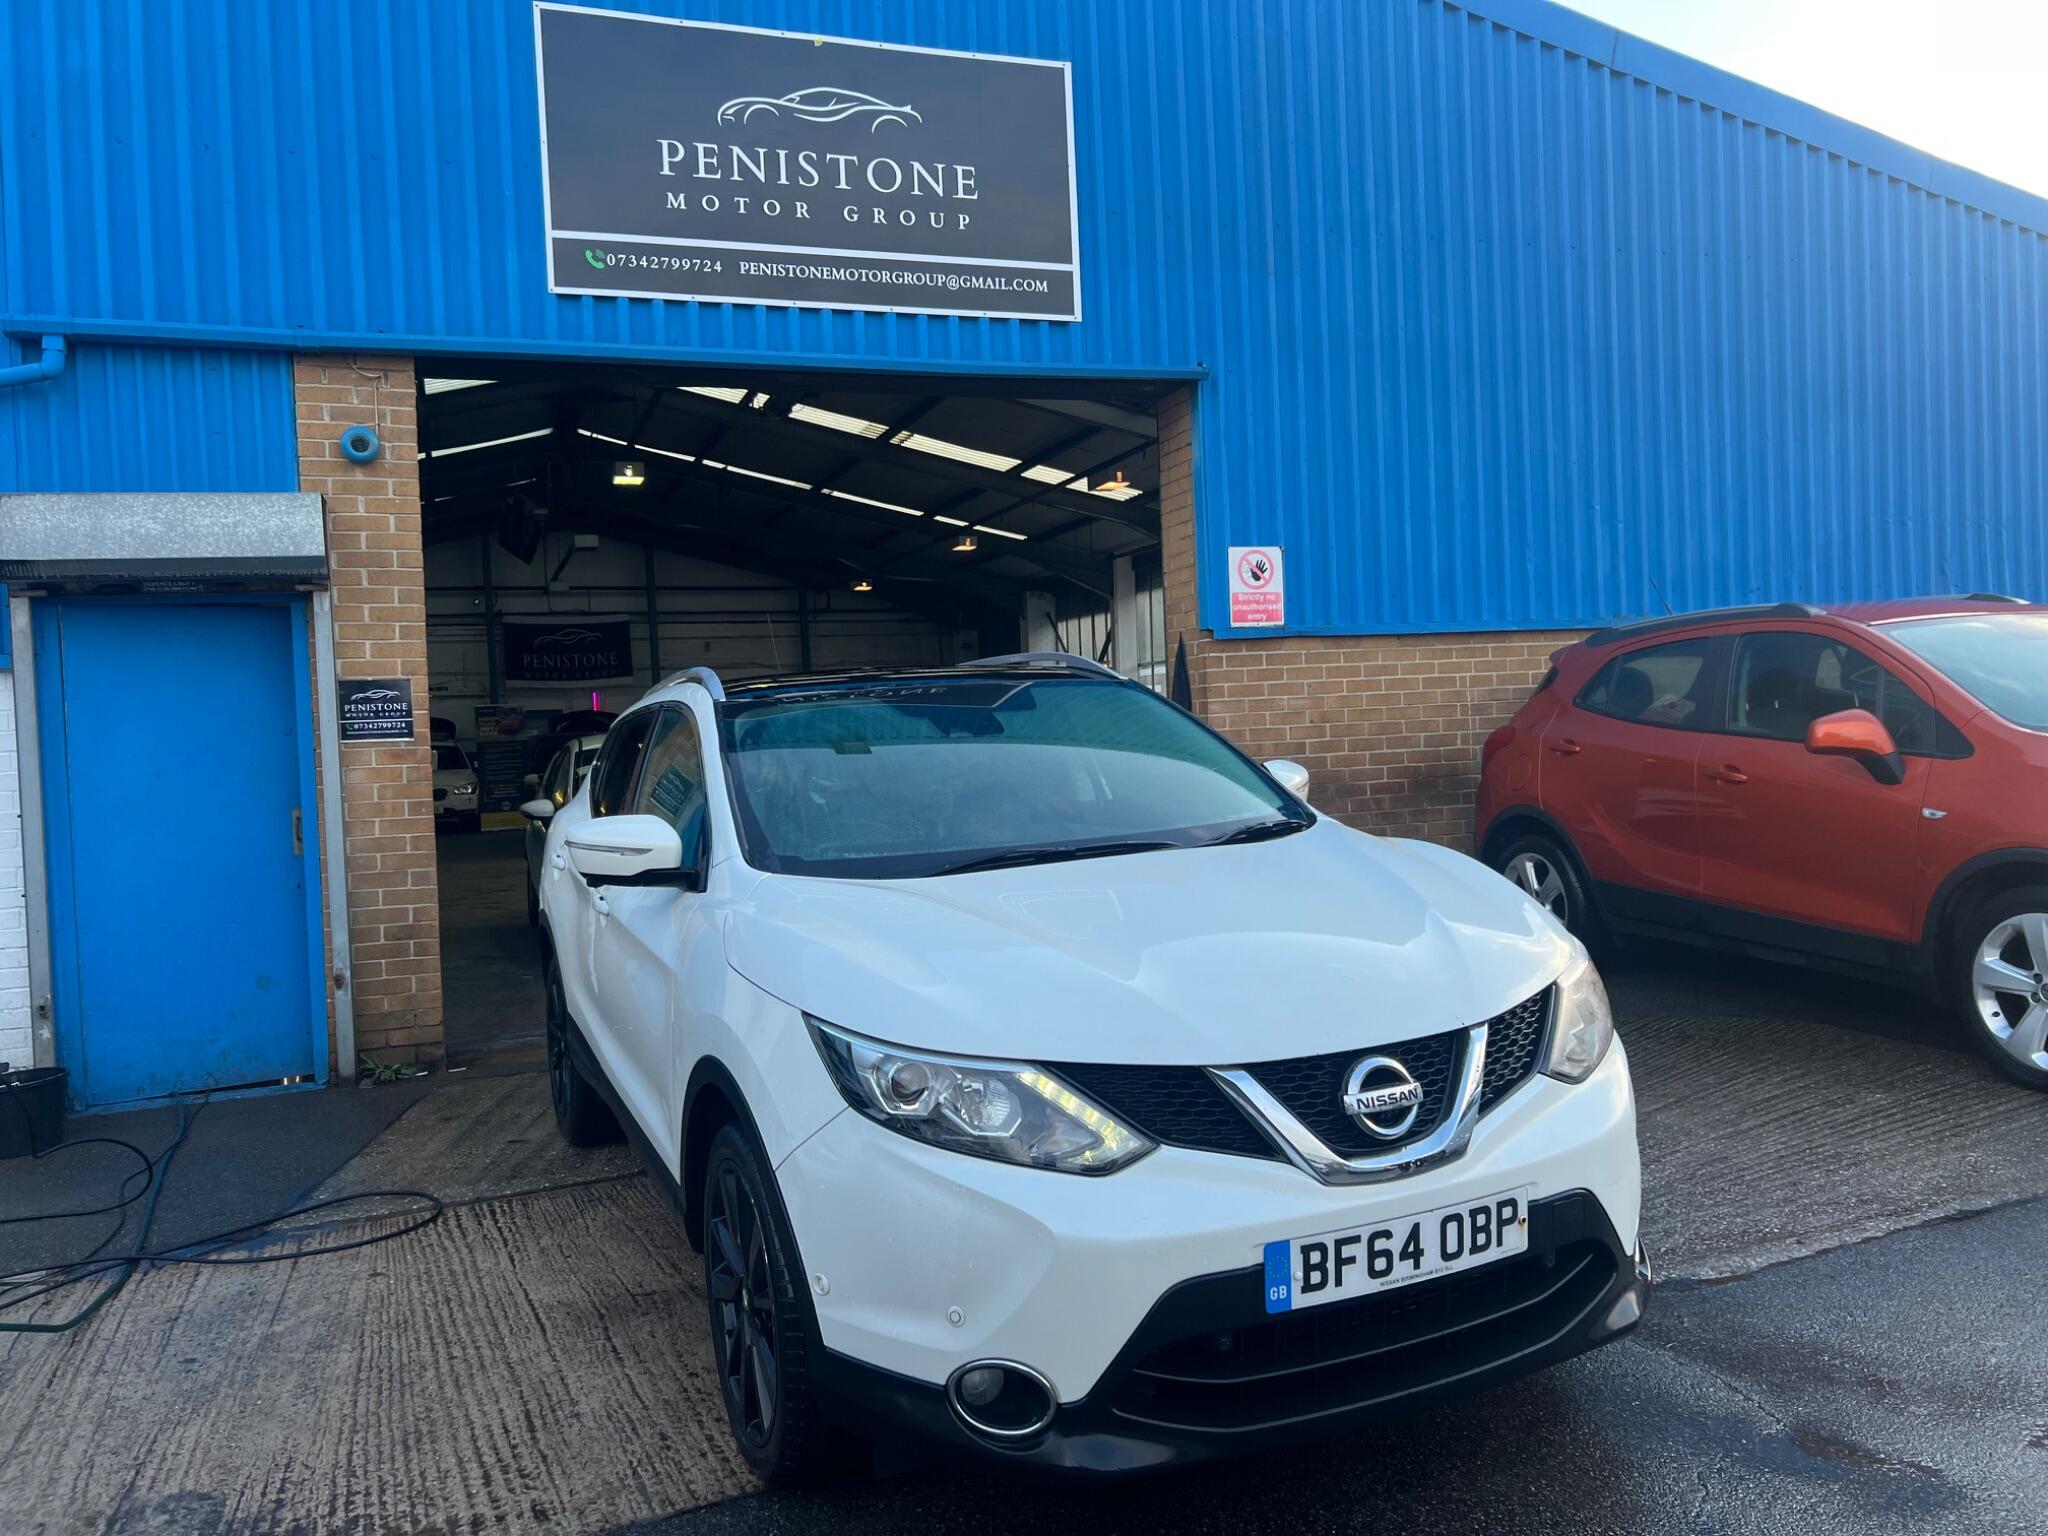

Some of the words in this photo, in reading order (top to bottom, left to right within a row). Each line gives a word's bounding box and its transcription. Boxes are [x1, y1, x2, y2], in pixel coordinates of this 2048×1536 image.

[656, 139, 978, 200] PENISTONE
[665, 192, 811, 219] MOTOR
[843, 205, 971, 230] GROUP
[606, 253, 723, 274] 07342799724
[739, 261, 1049, 293] PENISTONEMOTORGROUP@GMAIL.COM
[1238, 593, 1264, 602] Strictly
[1247, 613, 1267, 621] entry
[522, 651, 618, 668] PENISTONE
[344, 703, 408, 712] PENISTONE
[1356, 1088, 1419, 1110] NISSAN
[1300, 1222, 1424, 1294] BF64
[1439, 1197, 1519, 1263] OBP
[1270, 1285, 1287, 1300] GB
